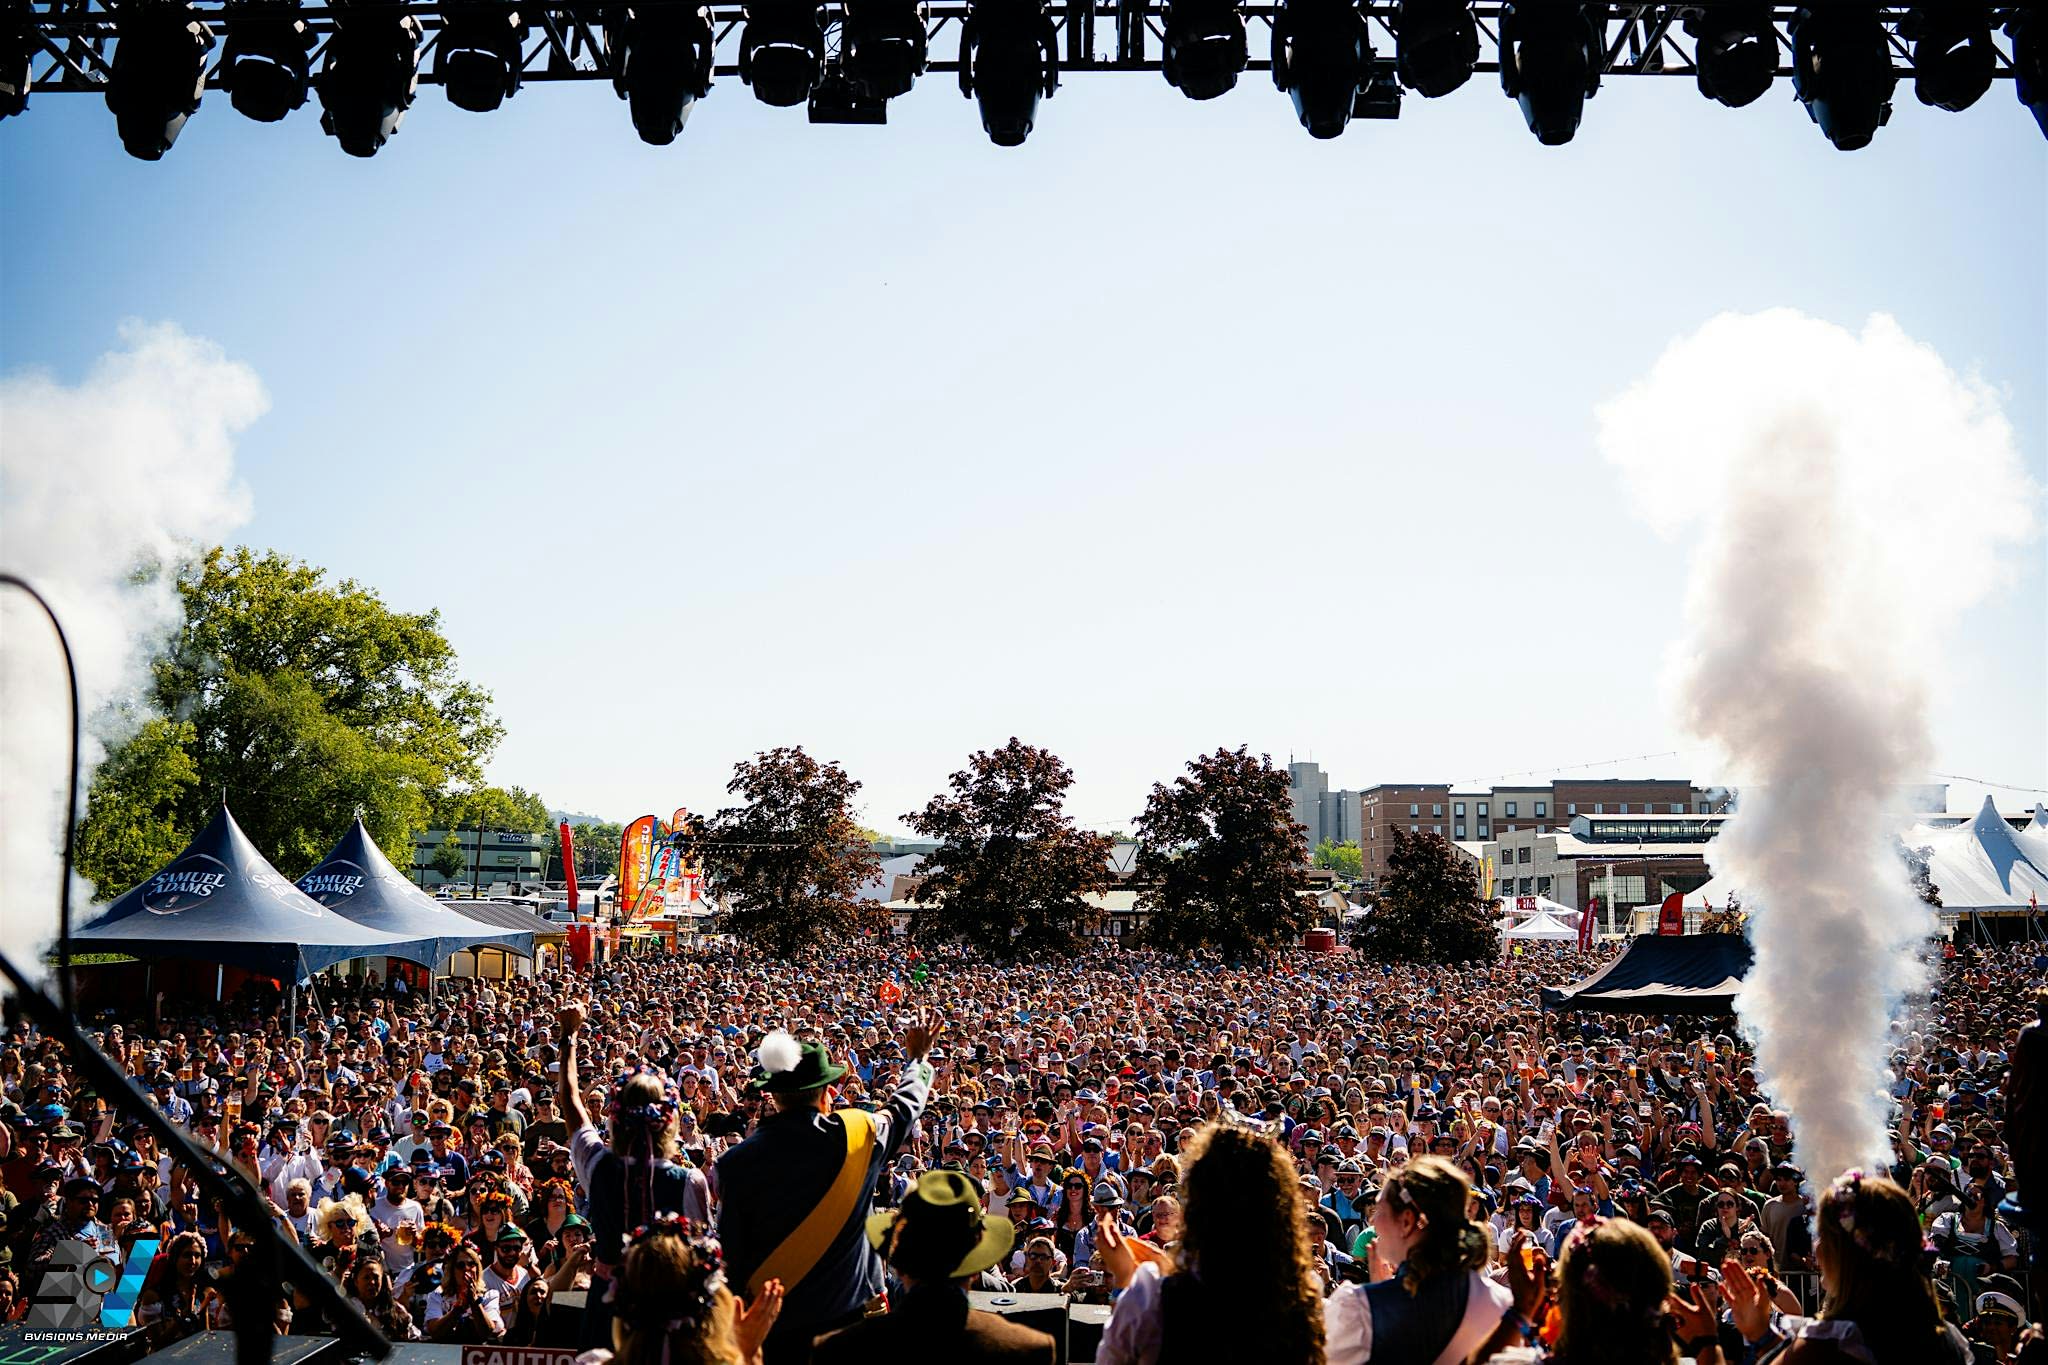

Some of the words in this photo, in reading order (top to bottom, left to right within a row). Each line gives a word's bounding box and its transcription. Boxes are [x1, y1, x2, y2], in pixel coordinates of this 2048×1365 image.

[151, 871, 226, 887] SAMUEL
[302, 874, 365, 888] SAMUEL
[147, 881, 214, 896] ADAMS
[304, 883, 355, 895] ADAMS
[466, 1350, 577, 1365] CAUTIO
